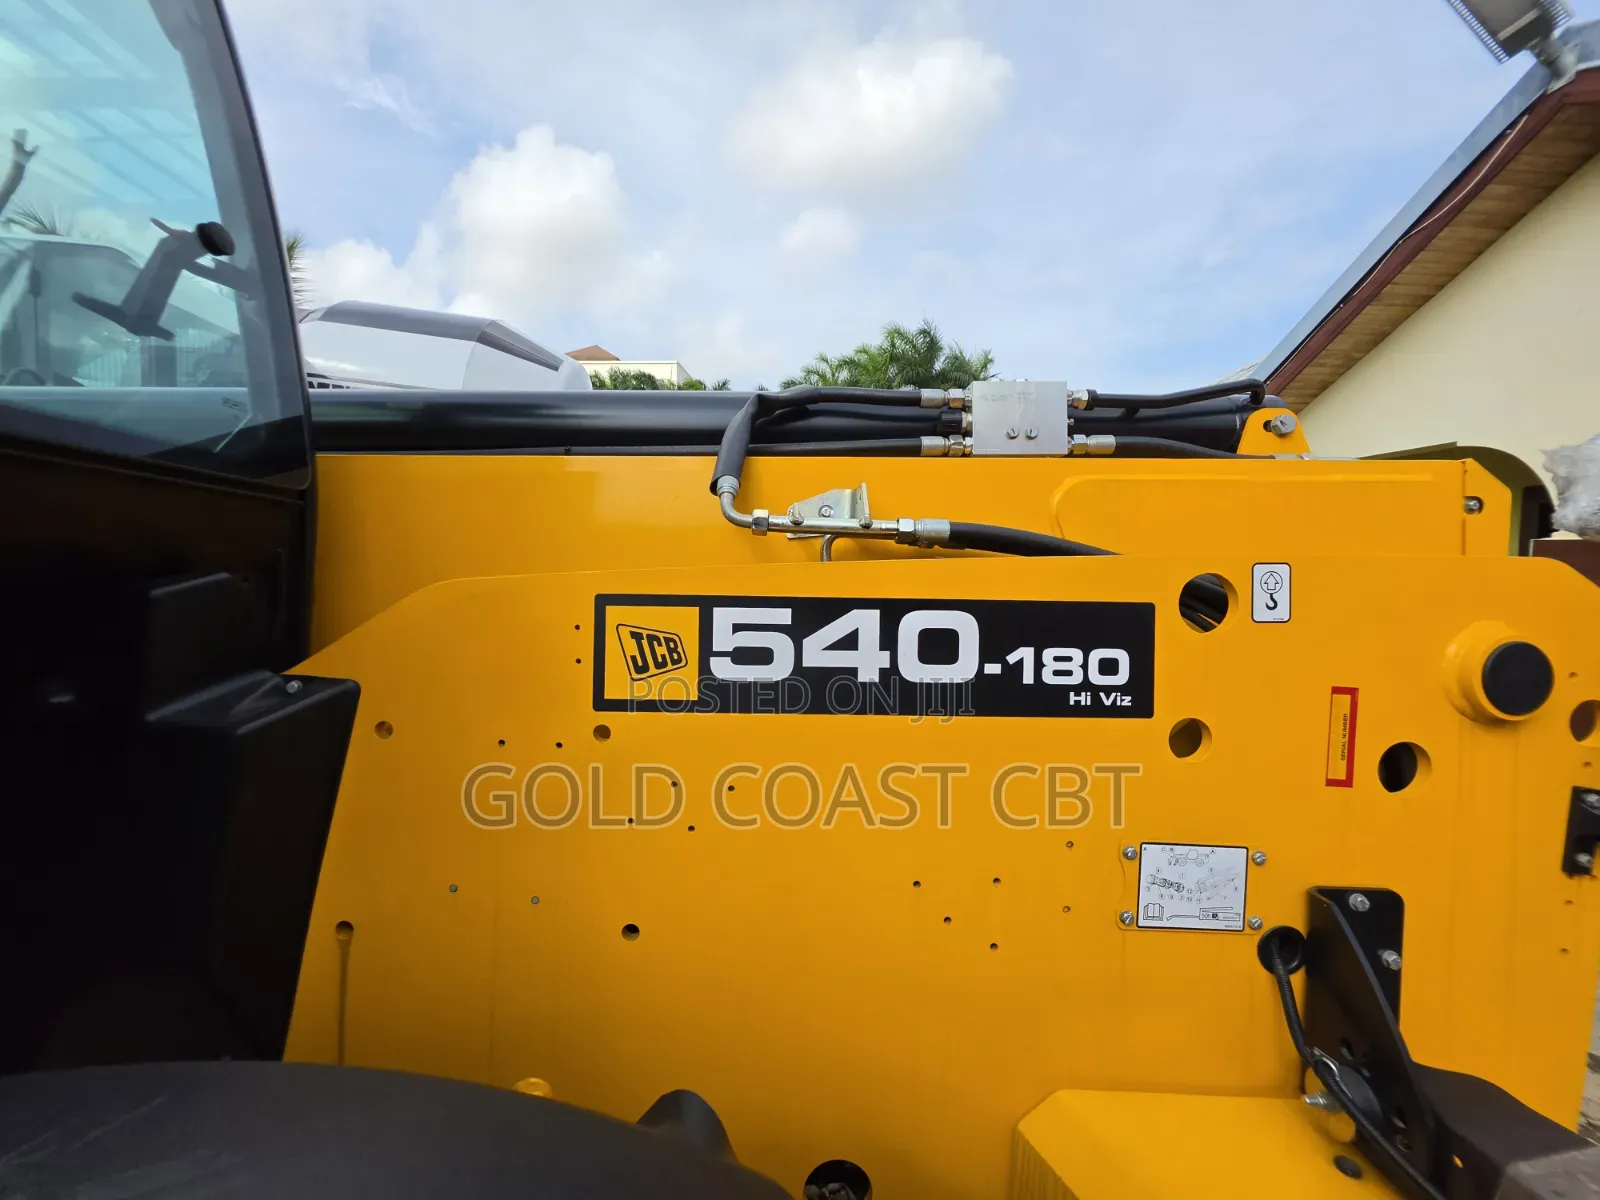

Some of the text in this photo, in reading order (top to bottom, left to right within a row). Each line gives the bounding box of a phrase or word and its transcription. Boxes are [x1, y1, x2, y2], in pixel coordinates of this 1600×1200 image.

[629, 630, 683, 675] JCB
[709, 607, 1131, 686] 540-180
[1069, 691, 1132, 706] Hi Viz
